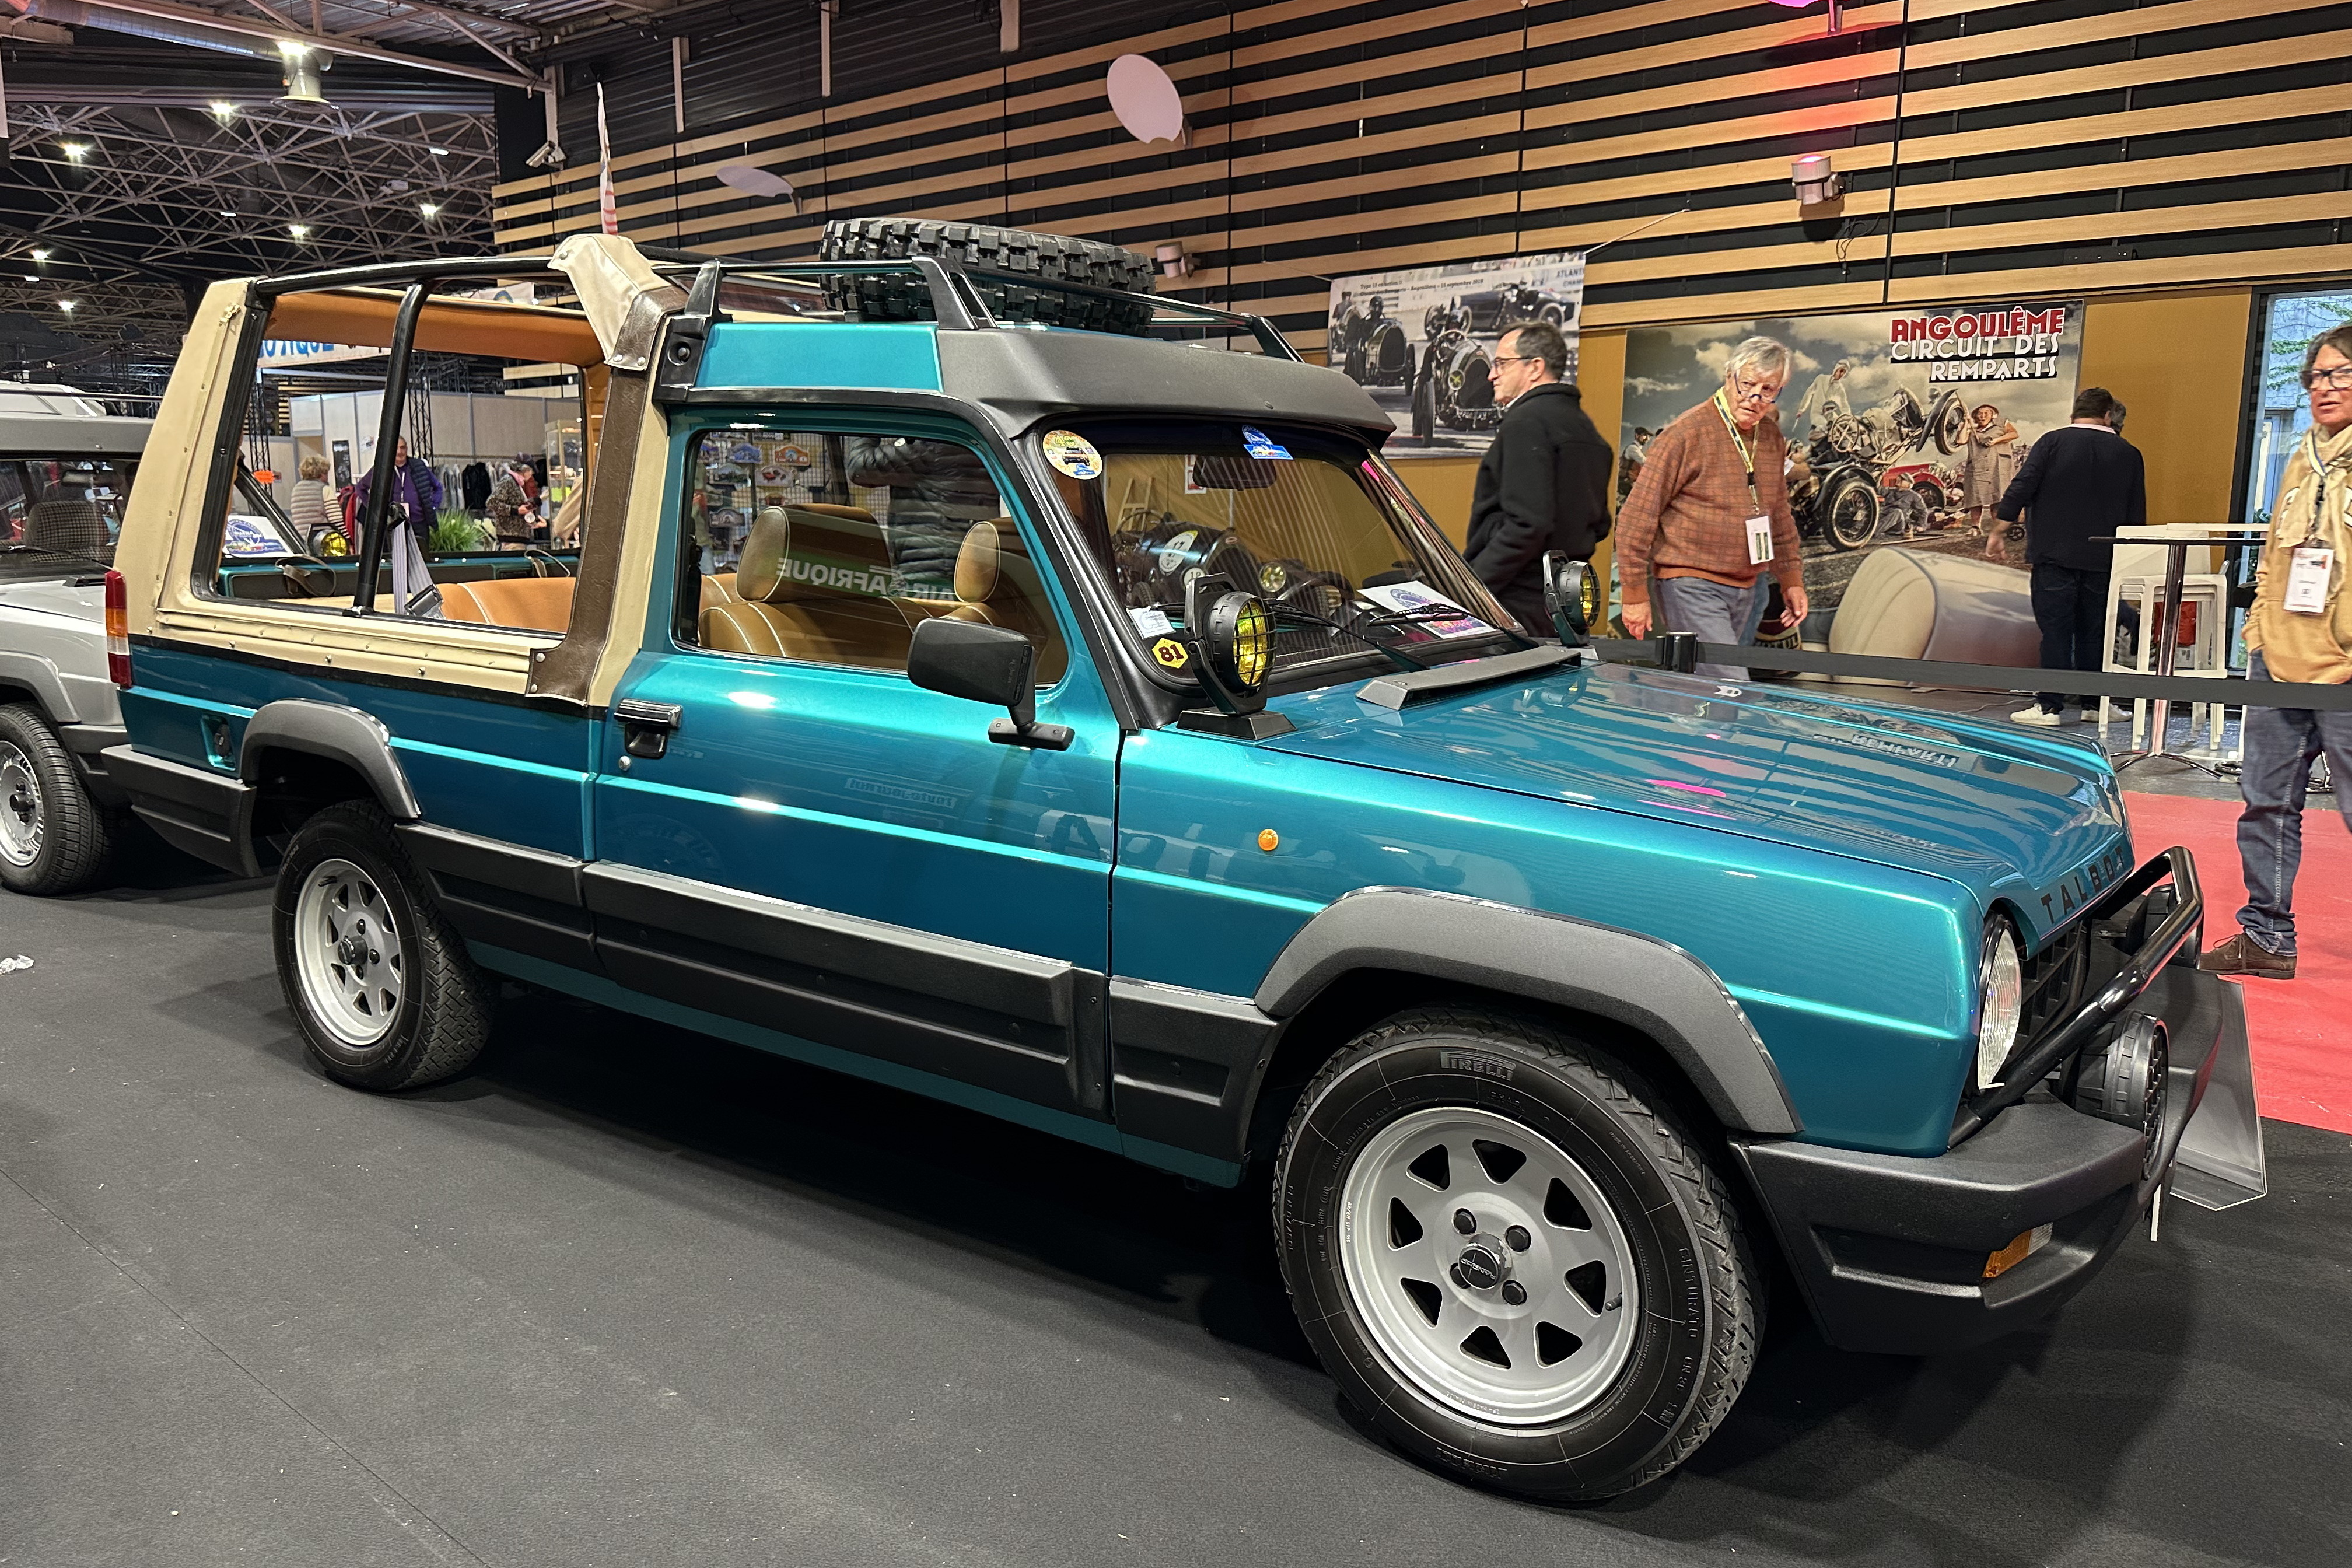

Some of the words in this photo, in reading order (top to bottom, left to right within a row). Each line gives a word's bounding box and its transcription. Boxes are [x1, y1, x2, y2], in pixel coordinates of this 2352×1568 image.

[1890, 306, 2066, 344] ANGOULÊME
[1891, 335, 1998, 360] CIRCUIT
[2015, 331, 2060, 355] DES
[1930, 355, 2057, 382] REMPARTS
[1158, 644, 1184, 662] 81
[2040, 846, 2124, 925] TALBOT
[1440, 1050, 1517, 1082] PIRELLI
